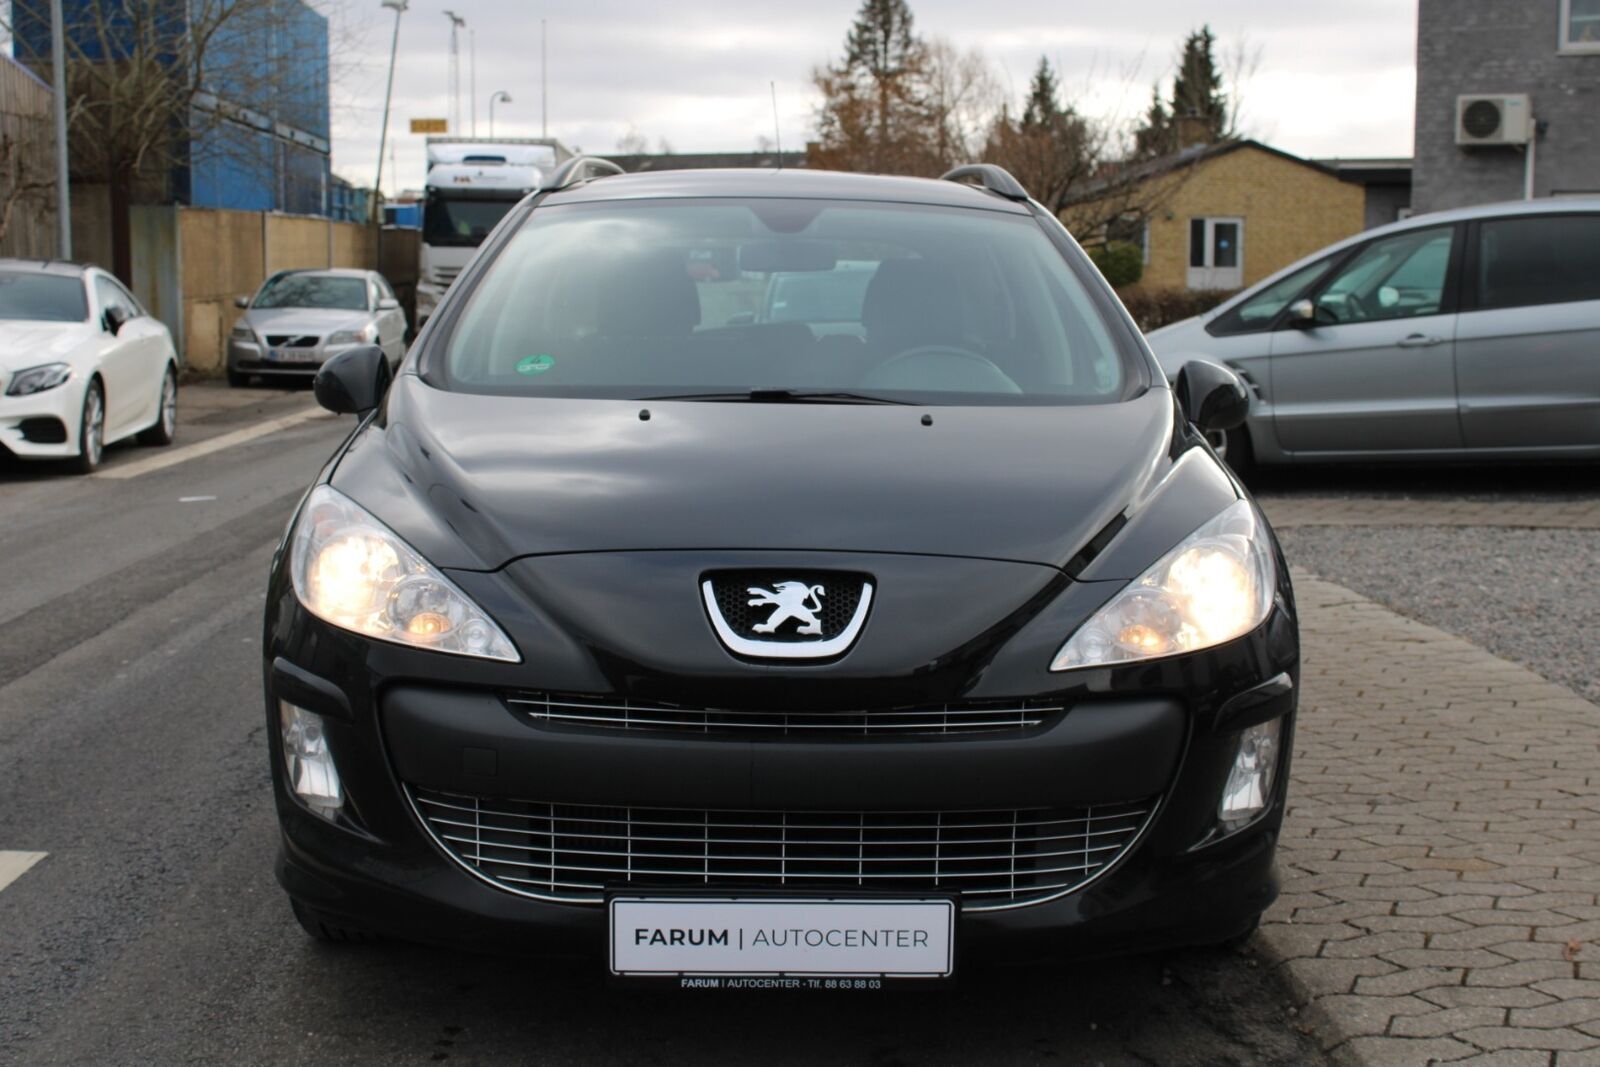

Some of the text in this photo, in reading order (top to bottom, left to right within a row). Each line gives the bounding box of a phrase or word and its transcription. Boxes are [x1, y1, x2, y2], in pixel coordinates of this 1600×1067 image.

[634, 928, 728, 946] FARUM
[752, 929, 929, 948] AUTOCENTER
[681, 979, 719, 988] FARUM
[727, 979, 800, 988] AUTOCENTER
[825, 980, 837, 989] 88
[839, 980, 852, 989] 63
[868, 980, 881, 989] 03
